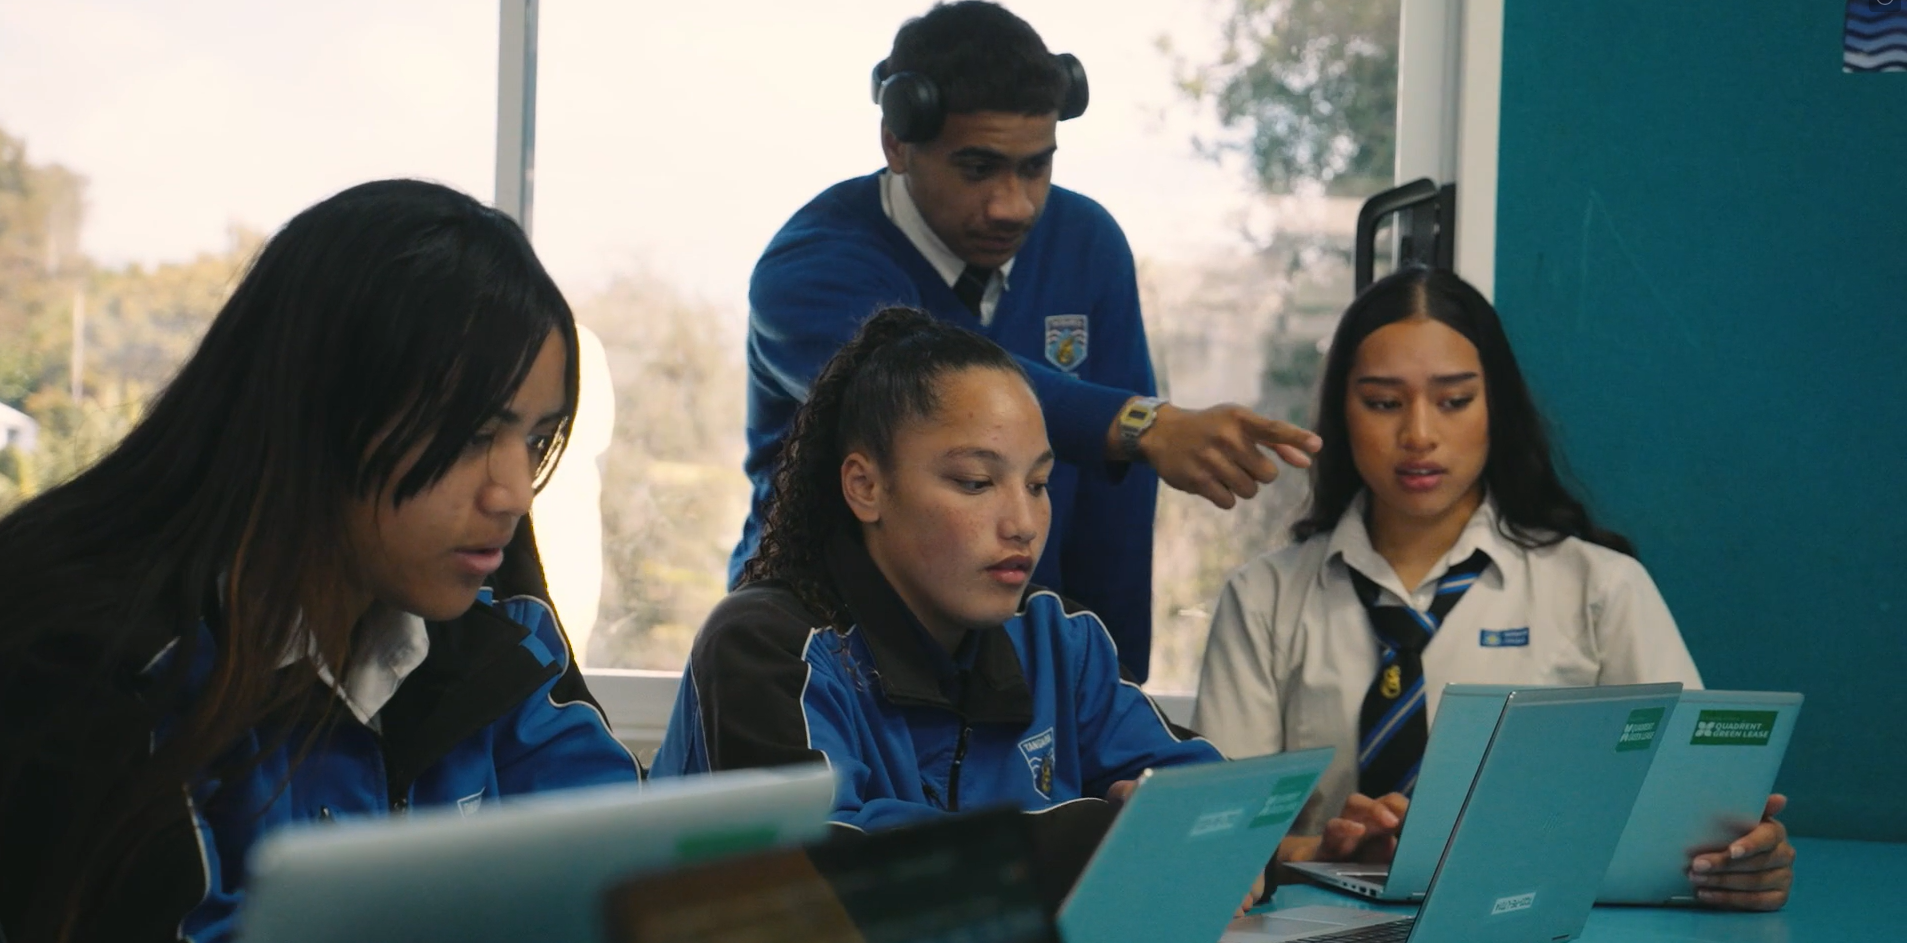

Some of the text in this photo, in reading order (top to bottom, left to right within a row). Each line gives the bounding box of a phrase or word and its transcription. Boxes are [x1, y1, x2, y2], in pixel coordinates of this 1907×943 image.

[1715, 722, 1762, 731] QUADRENT
[1713, 730, 1769, 738] GREEN LEASE
